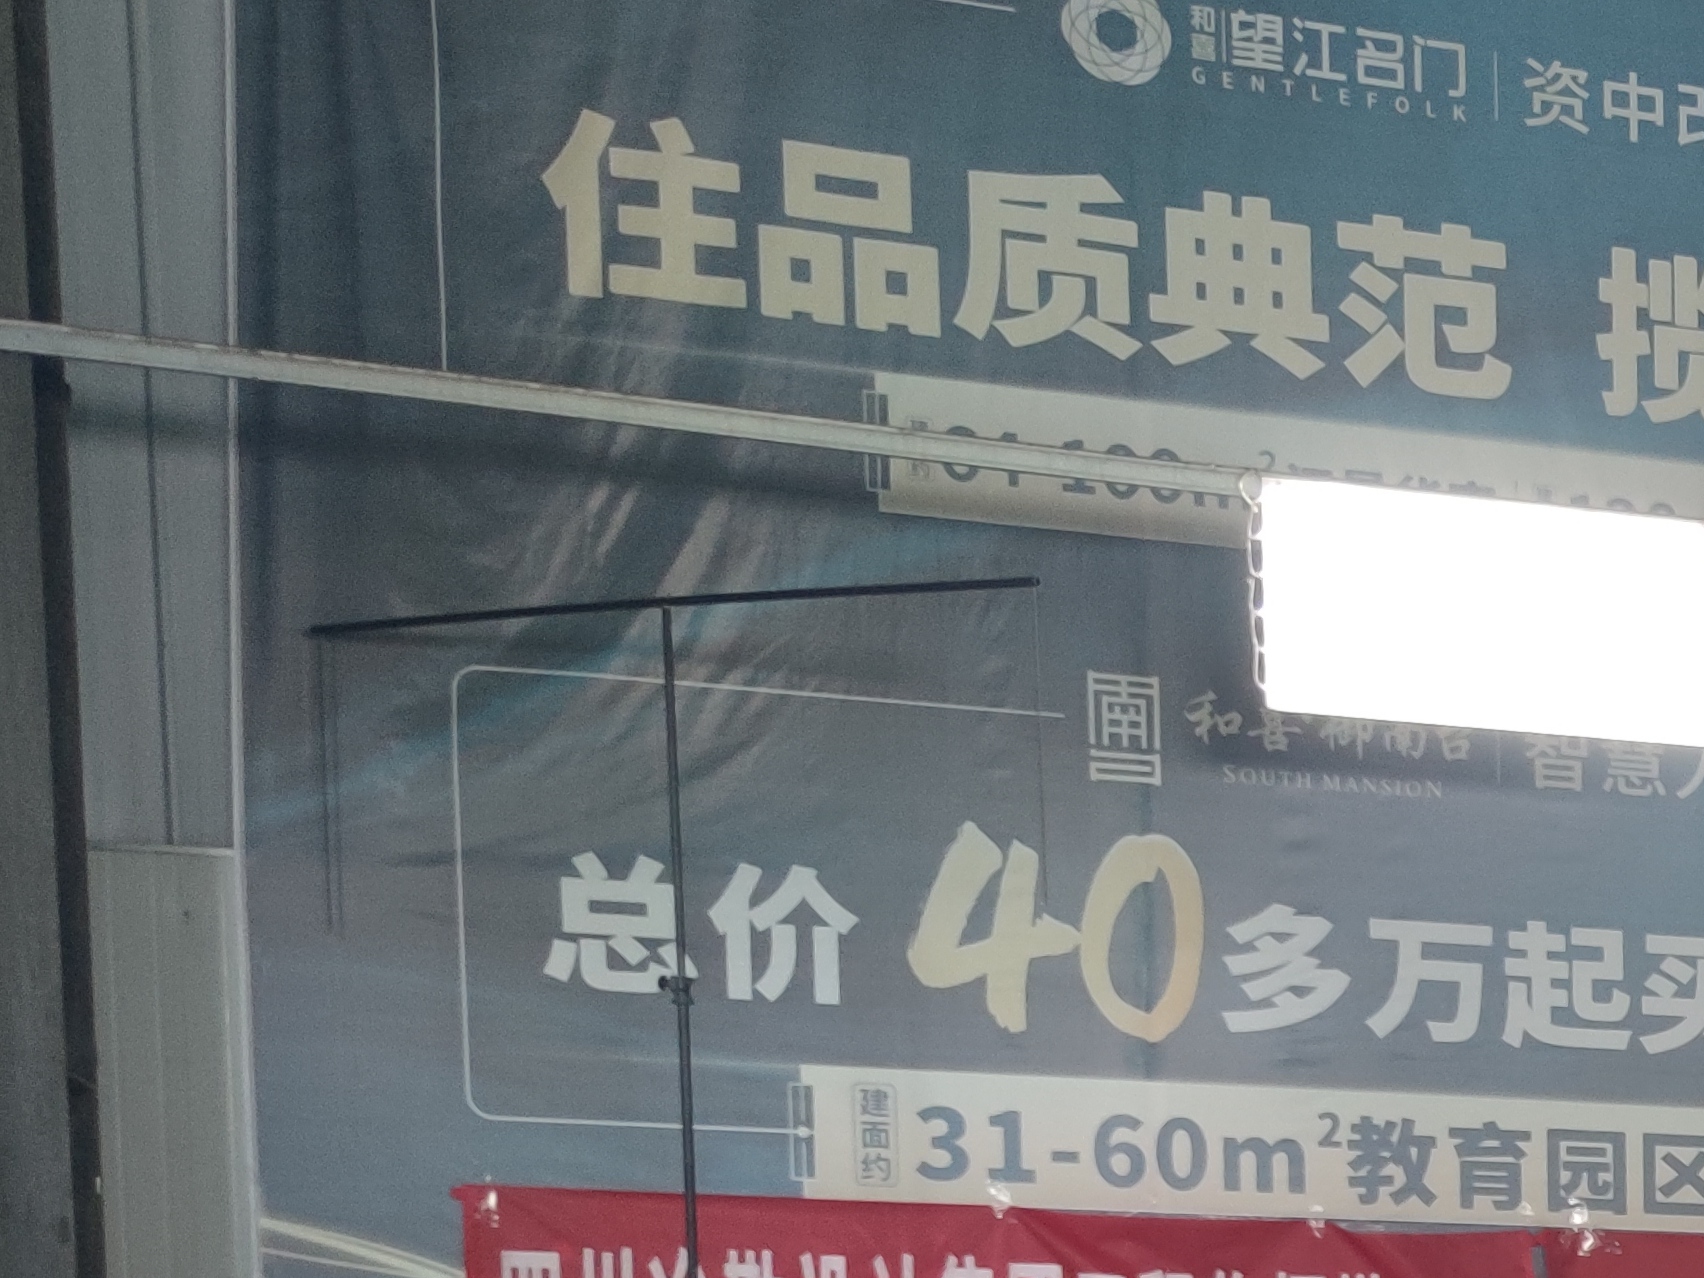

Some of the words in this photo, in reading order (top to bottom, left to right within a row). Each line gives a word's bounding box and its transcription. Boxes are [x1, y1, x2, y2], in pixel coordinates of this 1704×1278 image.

[1229, 9, 1468, 98] 望江名门
[1190, 65, 1468, 123] GENTLEFOLK
[540, 108, 1512, 399] 住品质典范
[1222, 763, 1312, 791] SOUTH
[1322, 772, 1443, 799] MANSION
